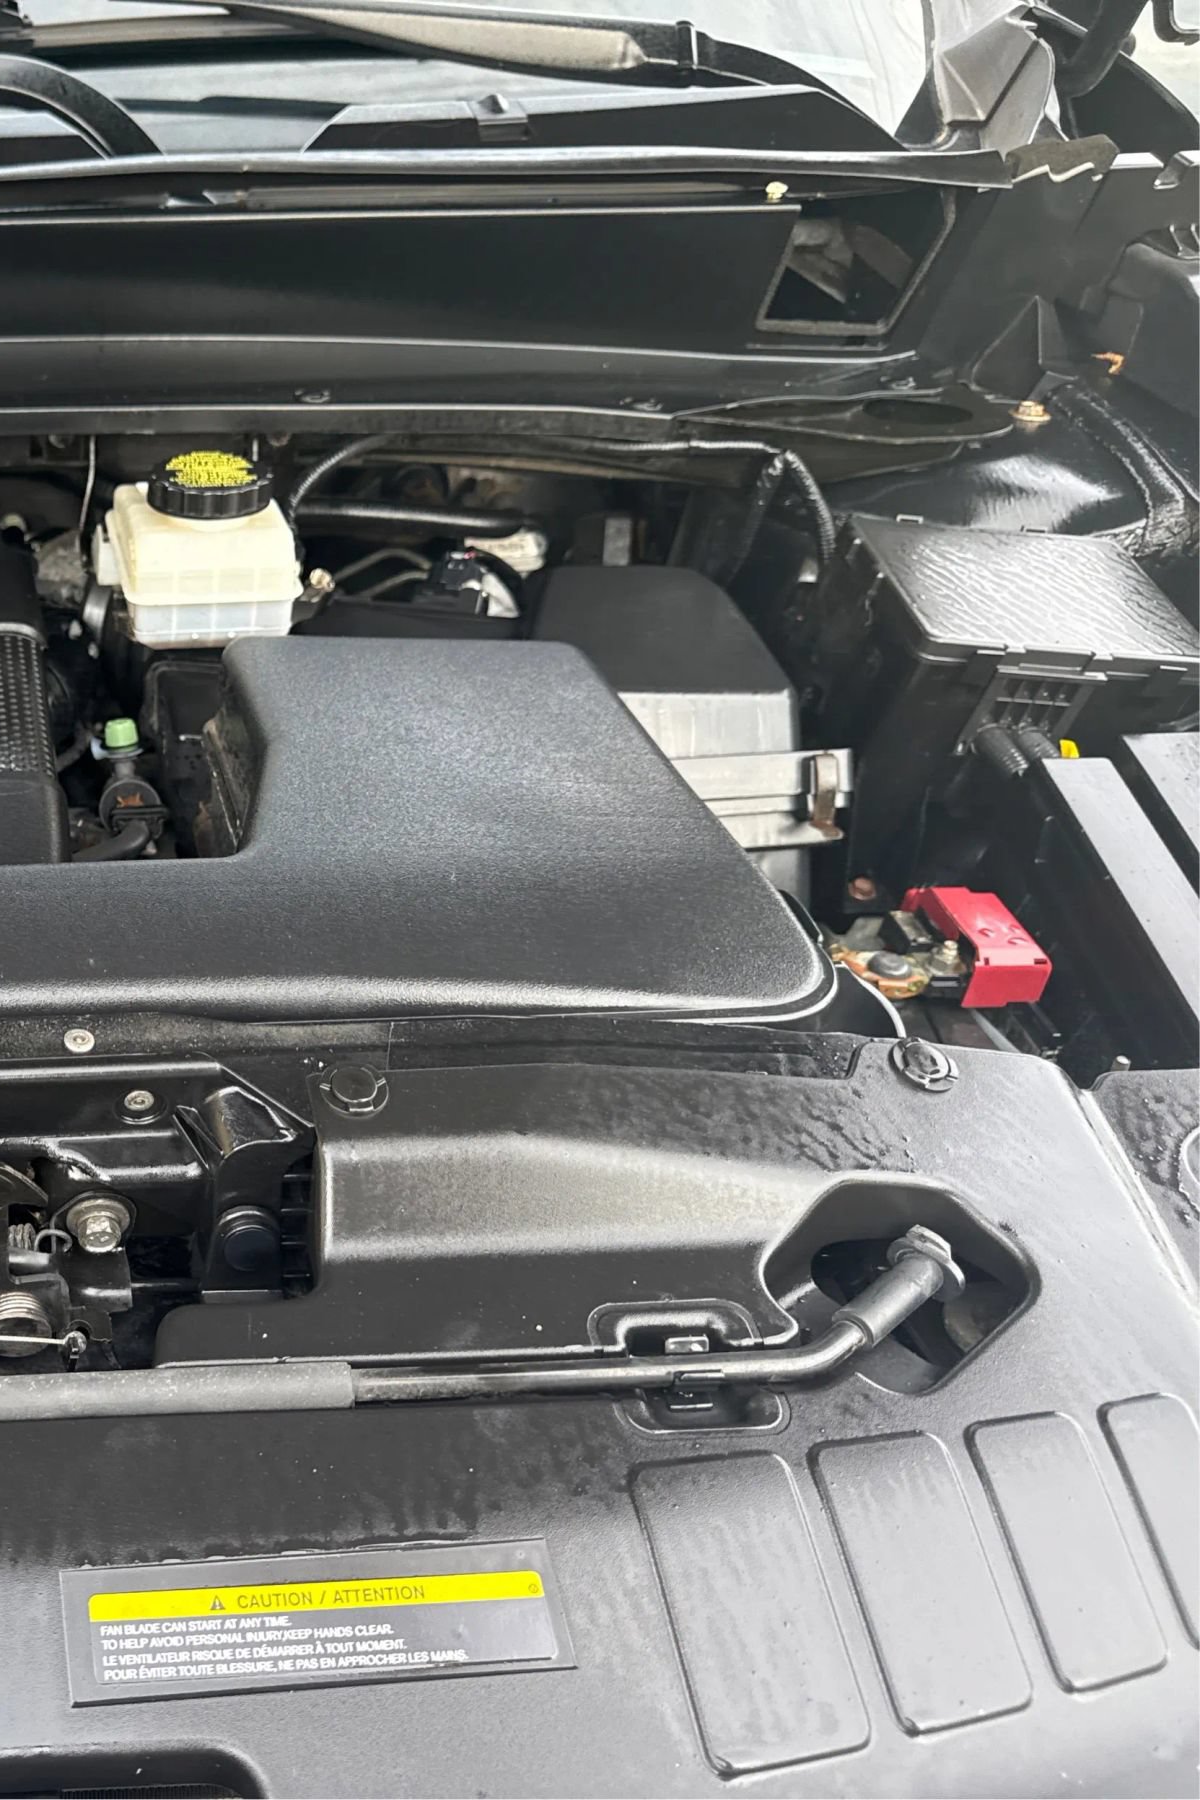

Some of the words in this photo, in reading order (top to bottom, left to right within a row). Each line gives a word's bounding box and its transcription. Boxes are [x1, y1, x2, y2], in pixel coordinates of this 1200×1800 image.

[237, 1591, 312, 1609] CAUTION
[320, 1591, 326, 1604] /
[333, 1585, 425, 1603] ATTENTION
[101, 1625, 122, 1636] FAN
[122, 1623, 161, 1635] BLADE
[162, 1622, 186, 1633] CAN
[188, 1619, 222, 1631] START
[224, 1619, 237, 1629] AT
[239, 1617, 261, 1628] ANY
[263, 1616, 292, 1627] TIME.
[101, 1640, 117, 1650] TO
[119, 1638, 148, 1649] HELP
[149, 1636, 184, 1648] AVOID
[185, 1633, 245, 1646] PERSONAL
[313, 1626, 353, 1639] HANDS
[354, 1624, 394, 1635] CLEAR.
[103, 1656, 117, 1666] LE
[118, 1652, 190, 1664] VENTILATEUR
[192, 1649, 233, 1662] RISQUE
[235, 1648, 251, 1658] DE
[253, 1644, 315, 1658] DÉMARRER
[316, 1641, 324, 1654] À
[325, 1641, 354, 1653] TOUT
[356, 1638, 407, 1651] MOMENT.
[104, 1669, 138, 1680] POUR
[139, 1665, 177, 1679] ÉVITER
[178, 1665, 214, 1676] TOUTE
[216, 1662, 277, 1675] BLESSURE,
[278, 1660, 295, 1670] NE
[295, 1658, 319, 1669] PAS
[320, 1657, 336, 1668] EN
[338, 1653, 406, 1668] APPROCHER
[408, 1651, 429, 1662] LES
[431, 1649, 469, 1662] MAINS.
